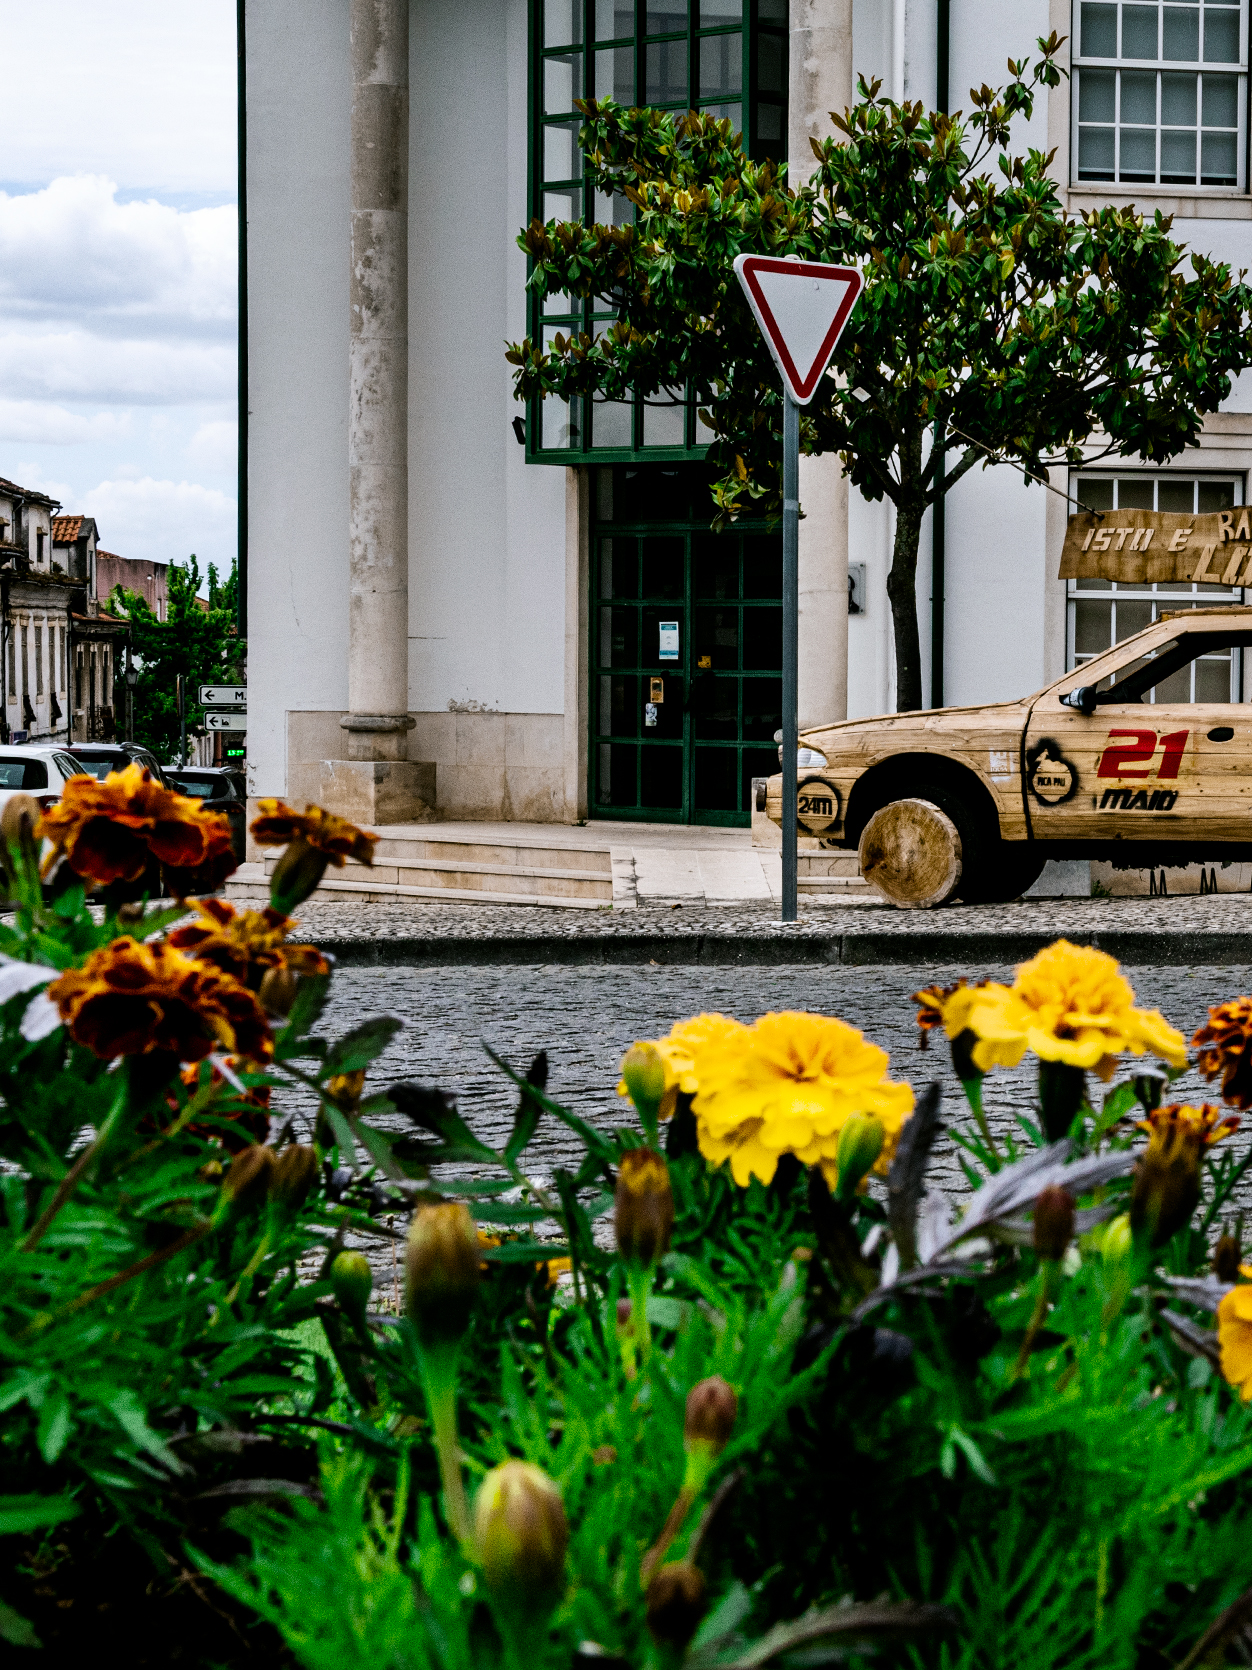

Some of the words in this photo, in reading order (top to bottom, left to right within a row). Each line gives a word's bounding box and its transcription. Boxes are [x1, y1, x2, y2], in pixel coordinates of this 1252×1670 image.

[1081, 527, 1155, 552] ISTO
[1097, 728, 1190, 780] 21
[1099, 788, 1178, 812] MAIO
